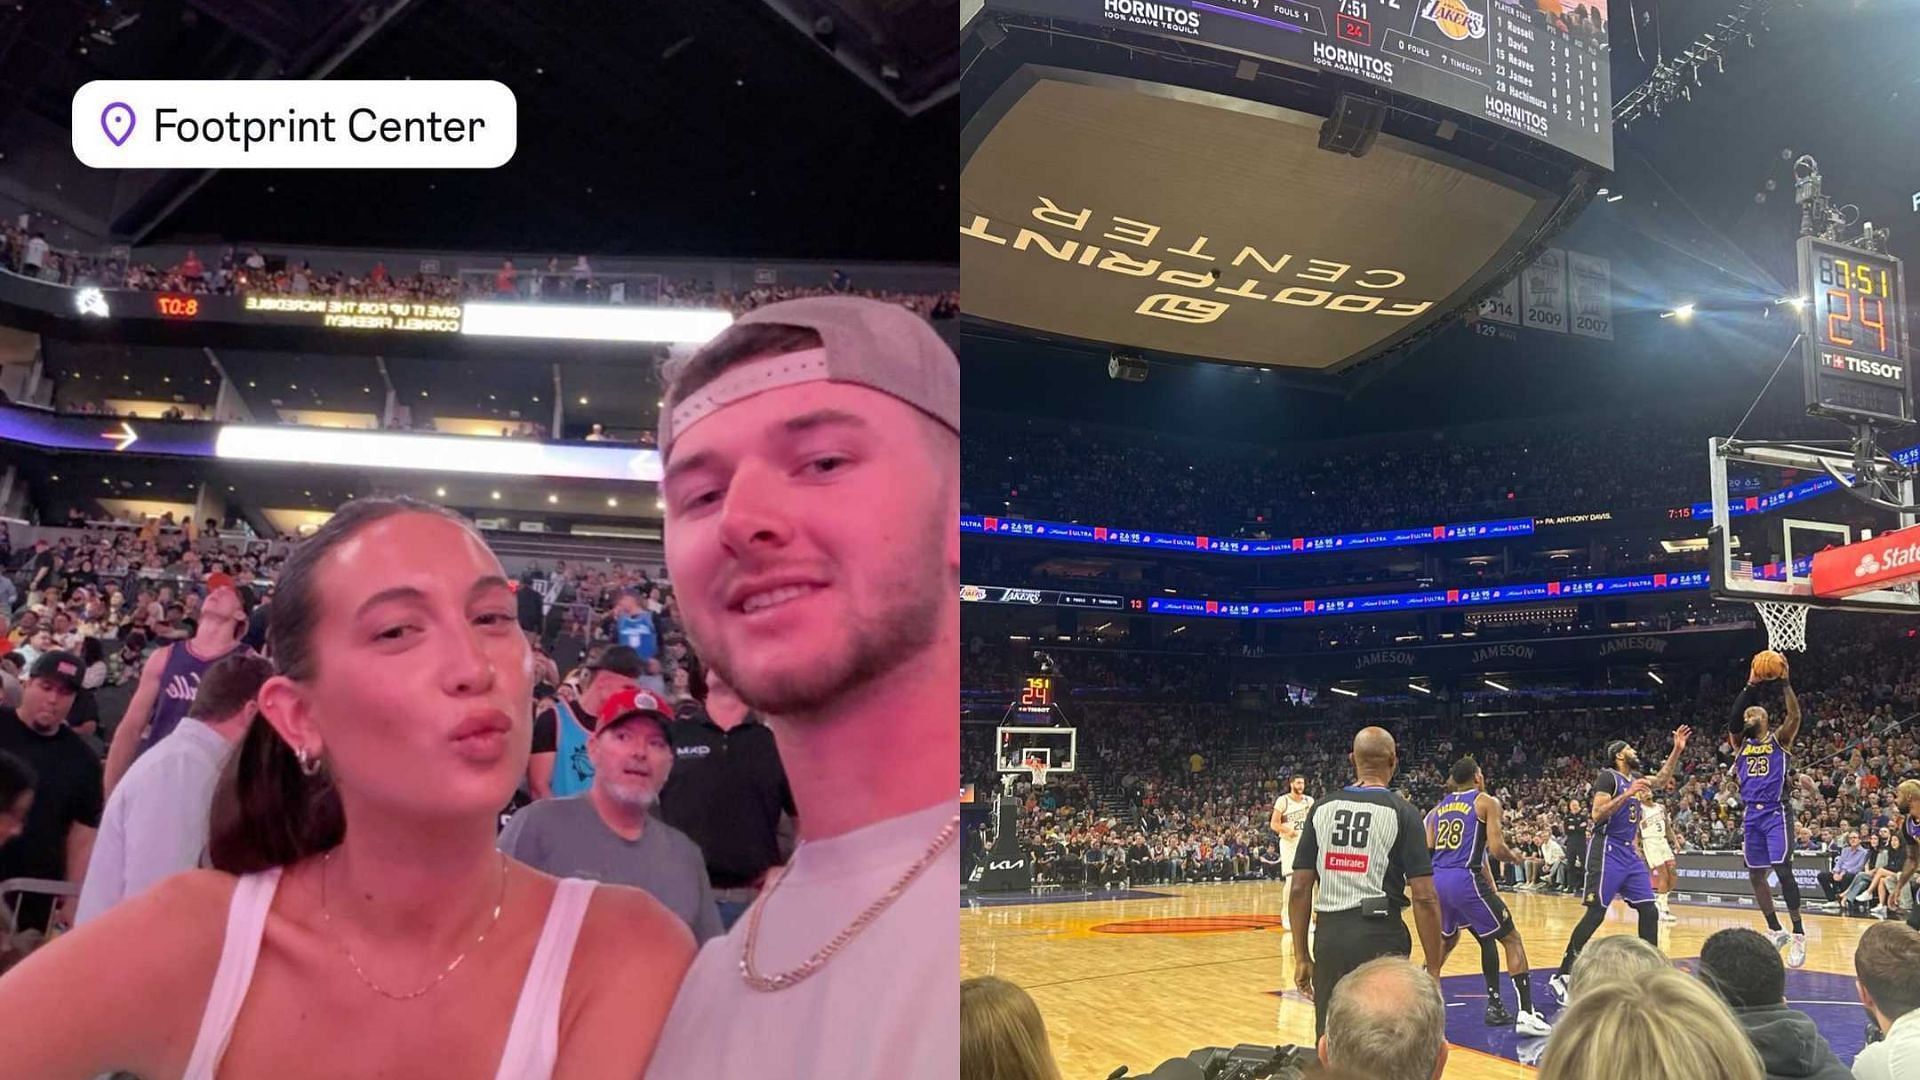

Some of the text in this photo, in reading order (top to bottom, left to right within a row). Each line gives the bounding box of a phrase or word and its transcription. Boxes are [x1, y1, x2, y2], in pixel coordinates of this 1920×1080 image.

[1105, 0, 1200, 27] HORNITOS
[1105, 12, 1199, 35] 100% AGAVE TEQUILA
[1274, 5, 1309, 21] FOULS 1
[1347, 24, 1362, 37] 24
[1497, 16, 1501, 27] 1
[1507, 21, 1534, 41] Russell
[1550, 40, 1555, 51] 2
[1313, 41, 1394, 77] HORNITOS
[1399, 41, 1430, 57] 0 FOULS
[1497, 32, 1502, 42] 3
[1508, 37, 1528, 54] Davis
[1551, 56, 1556, 66] 2
[1565, 64, 1570, 74] 2
[1313, 57, 1393, 83] 100% AGAVE TEQUILA
[1441, 55, 1482, 76] 7 TIMEOUTS
[1496, 48, 1504, 60] 15
[1508, 53, 1534, 72] Reaves
[1552, 72, 1556, 82] 3
[1567, 79, 1570, 89] 1
[1496, 64, 1505, 76] 23
[1509, 69, 1533, 87] James
[1566, 94, 1571, 104] 0
[1485, 94, 1548, 131] HORNITOS
[1509, 85, 1547, 109] Hachimura
[1553, 103, 1557, 114] 5
[1567, 110, 1571, 120] 2
[1031, 196, 1406, 290] CENTER
[960, 215, 1434, 317] FOOTPRINT
[1835, 259, 1888, 299] 7:51
[1528, 308, 1562, 325] 2009
[1576, 316, 1608, 333] 2007
[1826, 288, 1886, 353] 24
[1844, 356, 1902, 380] TISSOT
[1556, 514, 1589, 524] ANTHONY
[1668, 508, 1690, 519] 7:15
[1511, 523, 1531, 531] ULTRA
[1001, 587, 1042, 605] LAKERS
[1130, 600, 1142, 609] 13
[1472, 645, 1536, 664] JAMESON
[1599, 636, 1668, 657] JAMESON
[1355, 651, 1415, 670] JAMESON
[1022, 688, 1046, 705] 24
[1746, 756, 1769, 776] 23
[1294, 821, 1305, 831] 20
[1331, 809, 1372, 849] 38
[1435, 818, 1465, 850] 28
[1655, 822, 1663, 832] 3
[1329, 856, 1366, 868] Emirates
